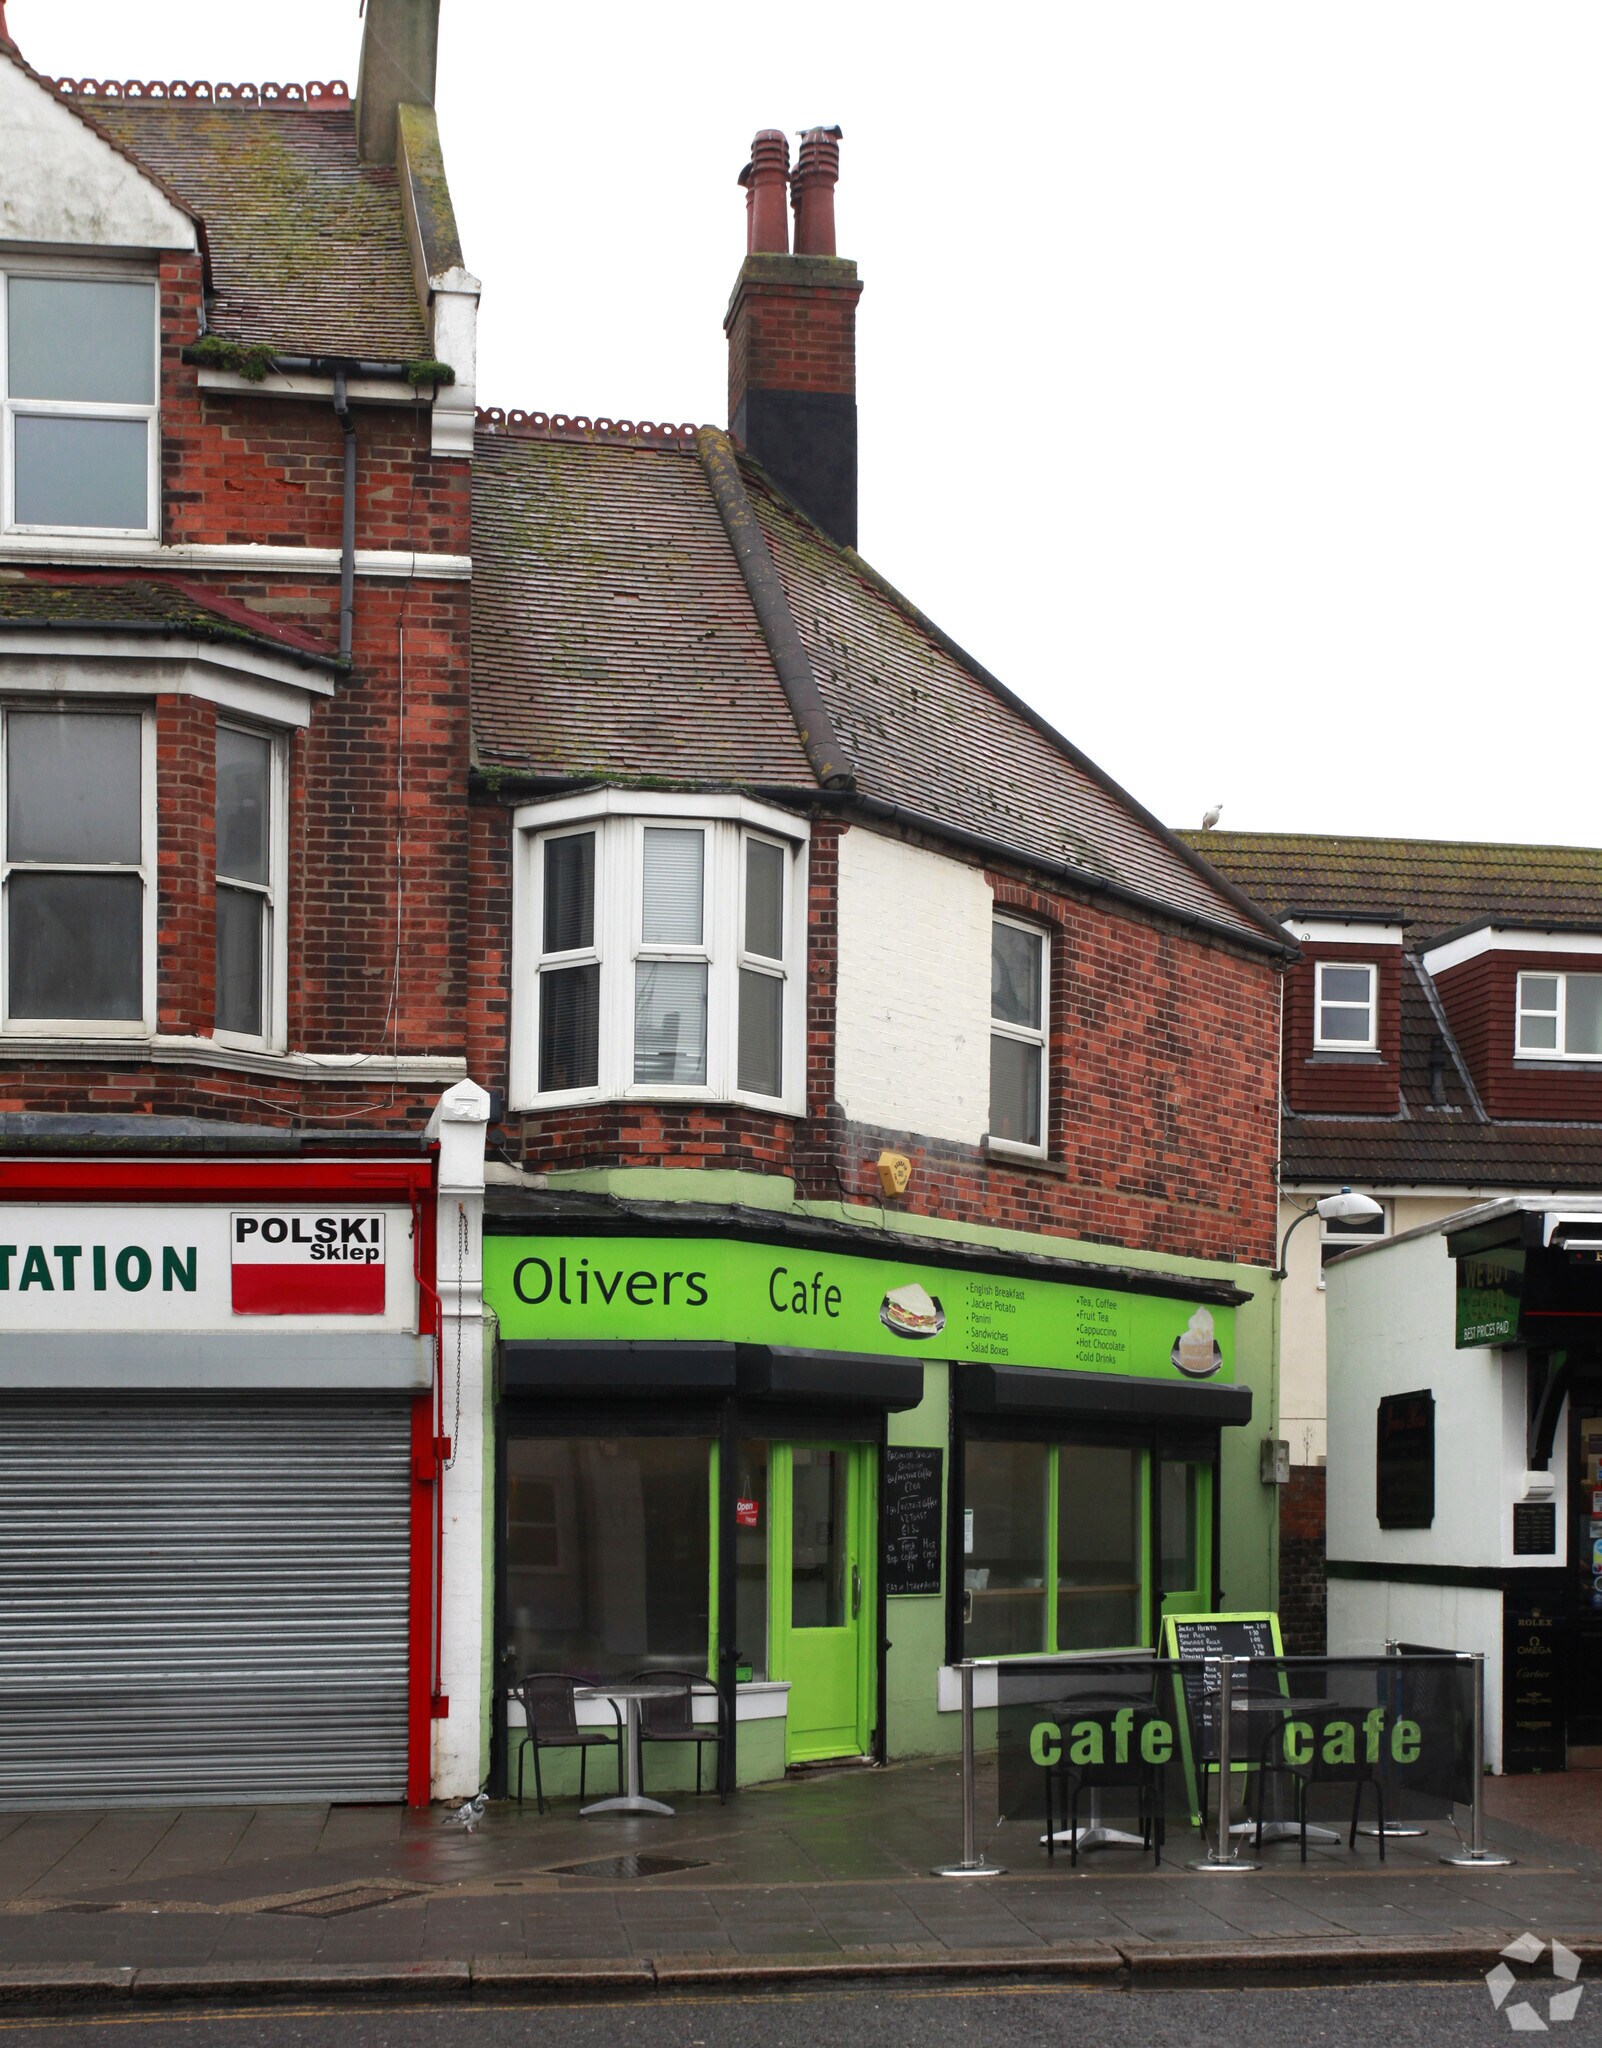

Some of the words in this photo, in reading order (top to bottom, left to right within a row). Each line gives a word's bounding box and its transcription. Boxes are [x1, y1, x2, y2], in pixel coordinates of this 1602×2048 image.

[236, 1217, 380, 1243] POLSKI
[310, 1243, 380, 1263] Sklep
[1465, 1261, 1484, 1288] WE
[512, 1256, 709, 1306] Olivers
[769, 1266, 842, 1318] Cafe
[970, 1282, 993, 1296] English
[995, 1286, 1025, 1300] Breakfast
[971, 1298, 993, 1310] Jacket
[994, 1300, 1016, 1313] Potato
[1080, 1295, 1094, 1308] Tea,
[1095, 1298, 1117, 1310] Coffee
[971, 1312, 992, 1324] Panini
[1080, 1309, 1096, 1321] Fruit
[1098, 1311, 1109, 1322] Tea
[971, 1326, 1009, 1341] Sandwiches
[1080, 1323, 1118, 1337] Cappuccino
[1464, 1326, 1477, 1341] BEST
[1477, 1322, 1496, 1338] PRICES
[1496, 1320, 1509, 1334] PAID
[971, 1341, 989, 1353] Salad
[990, 1344, 1009, 1356] Boxes
[1080, 1337, 1092, 1348] Hot
[1093, 1338, 1126, 1351] Chocolate
[1079, 1351, 1095, 1364] Cold
[1096, 1352, 1116, 1365] Drinks
[737, 1502, 754, 1513] Open
[1517, 1647, 1552, 1655] OMEGA
[1516, 1667, 1552, 1679] Cartier
[1030, 1708, 1173, 1766] cafe
[1283, 1708, 1422, 1766] cafe
